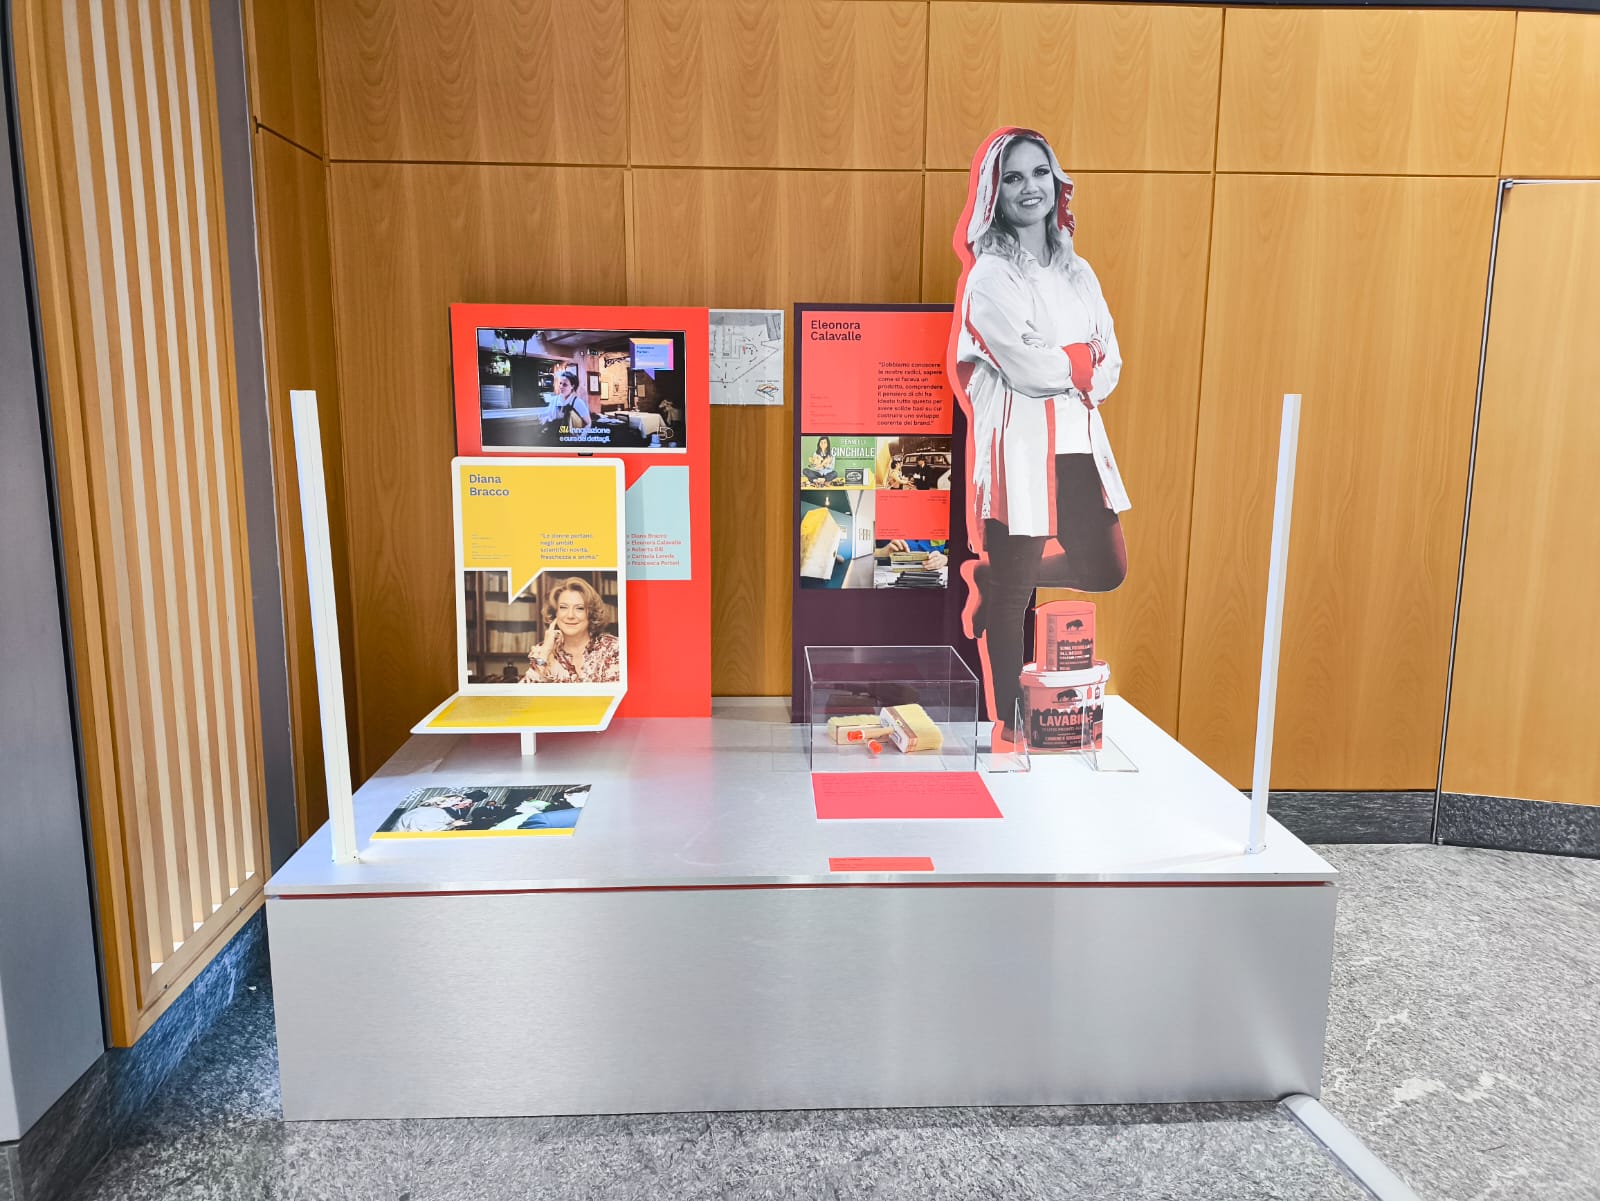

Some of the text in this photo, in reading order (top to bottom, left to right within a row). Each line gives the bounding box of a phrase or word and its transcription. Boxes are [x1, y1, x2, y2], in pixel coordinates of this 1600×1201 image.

[811, 320, 860, 329] Eleonora
[811, 331, 861, 340] Calavalle
[831, 447, 875, 457] CINGHIALE
[469, 474, 502, 483] Diana
[469, 487, 510, 496] Bracco
